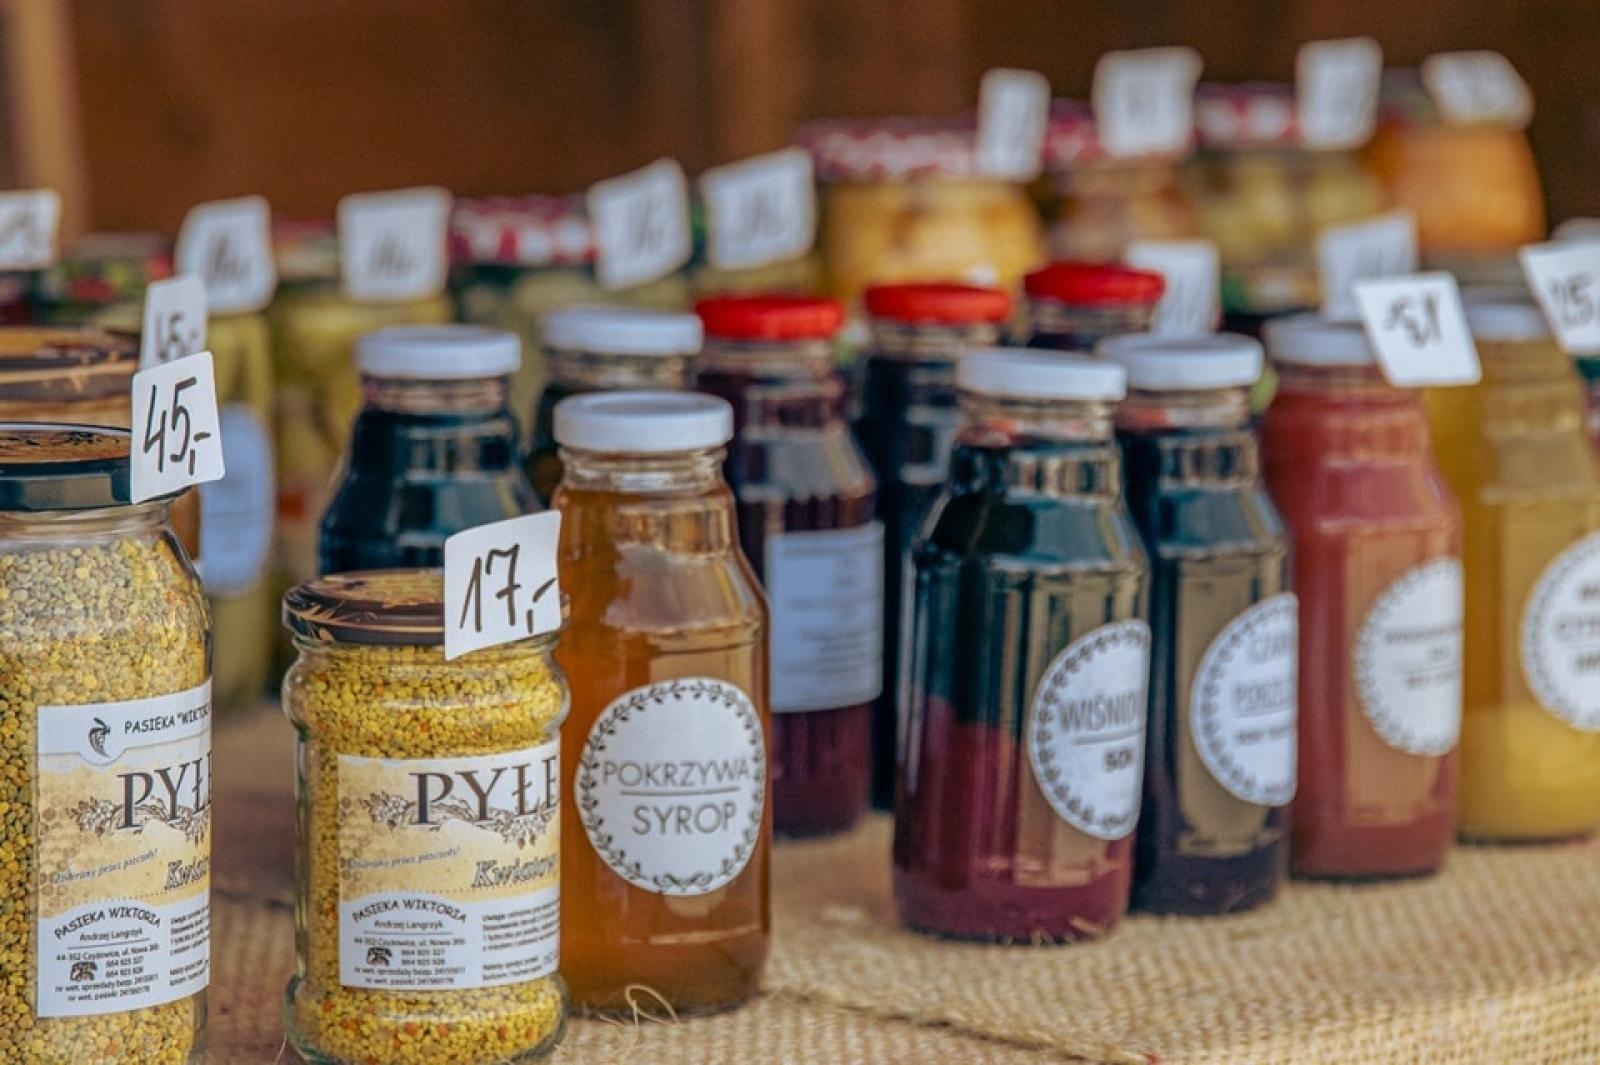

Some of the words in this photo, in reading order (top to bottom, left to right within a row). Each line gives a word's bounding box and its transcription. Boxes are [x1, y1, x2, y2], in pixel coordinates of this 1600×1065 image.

[144, 376, 211, 475] 45,-
[459, 543, 557, 633] 17,-
[124, 714, 175, 735] PASIEKA
[603, 759, 750, 786] POKRZYWA
[632, 801, 737, 836] SYROP
[54, 909, 106, 940] PASIEKA
[108, 906, 161, 928] WIKTORIA
[352, 900, 399, 923] PASIEKA
[402, 898, 467, 923] WIKTORIA
